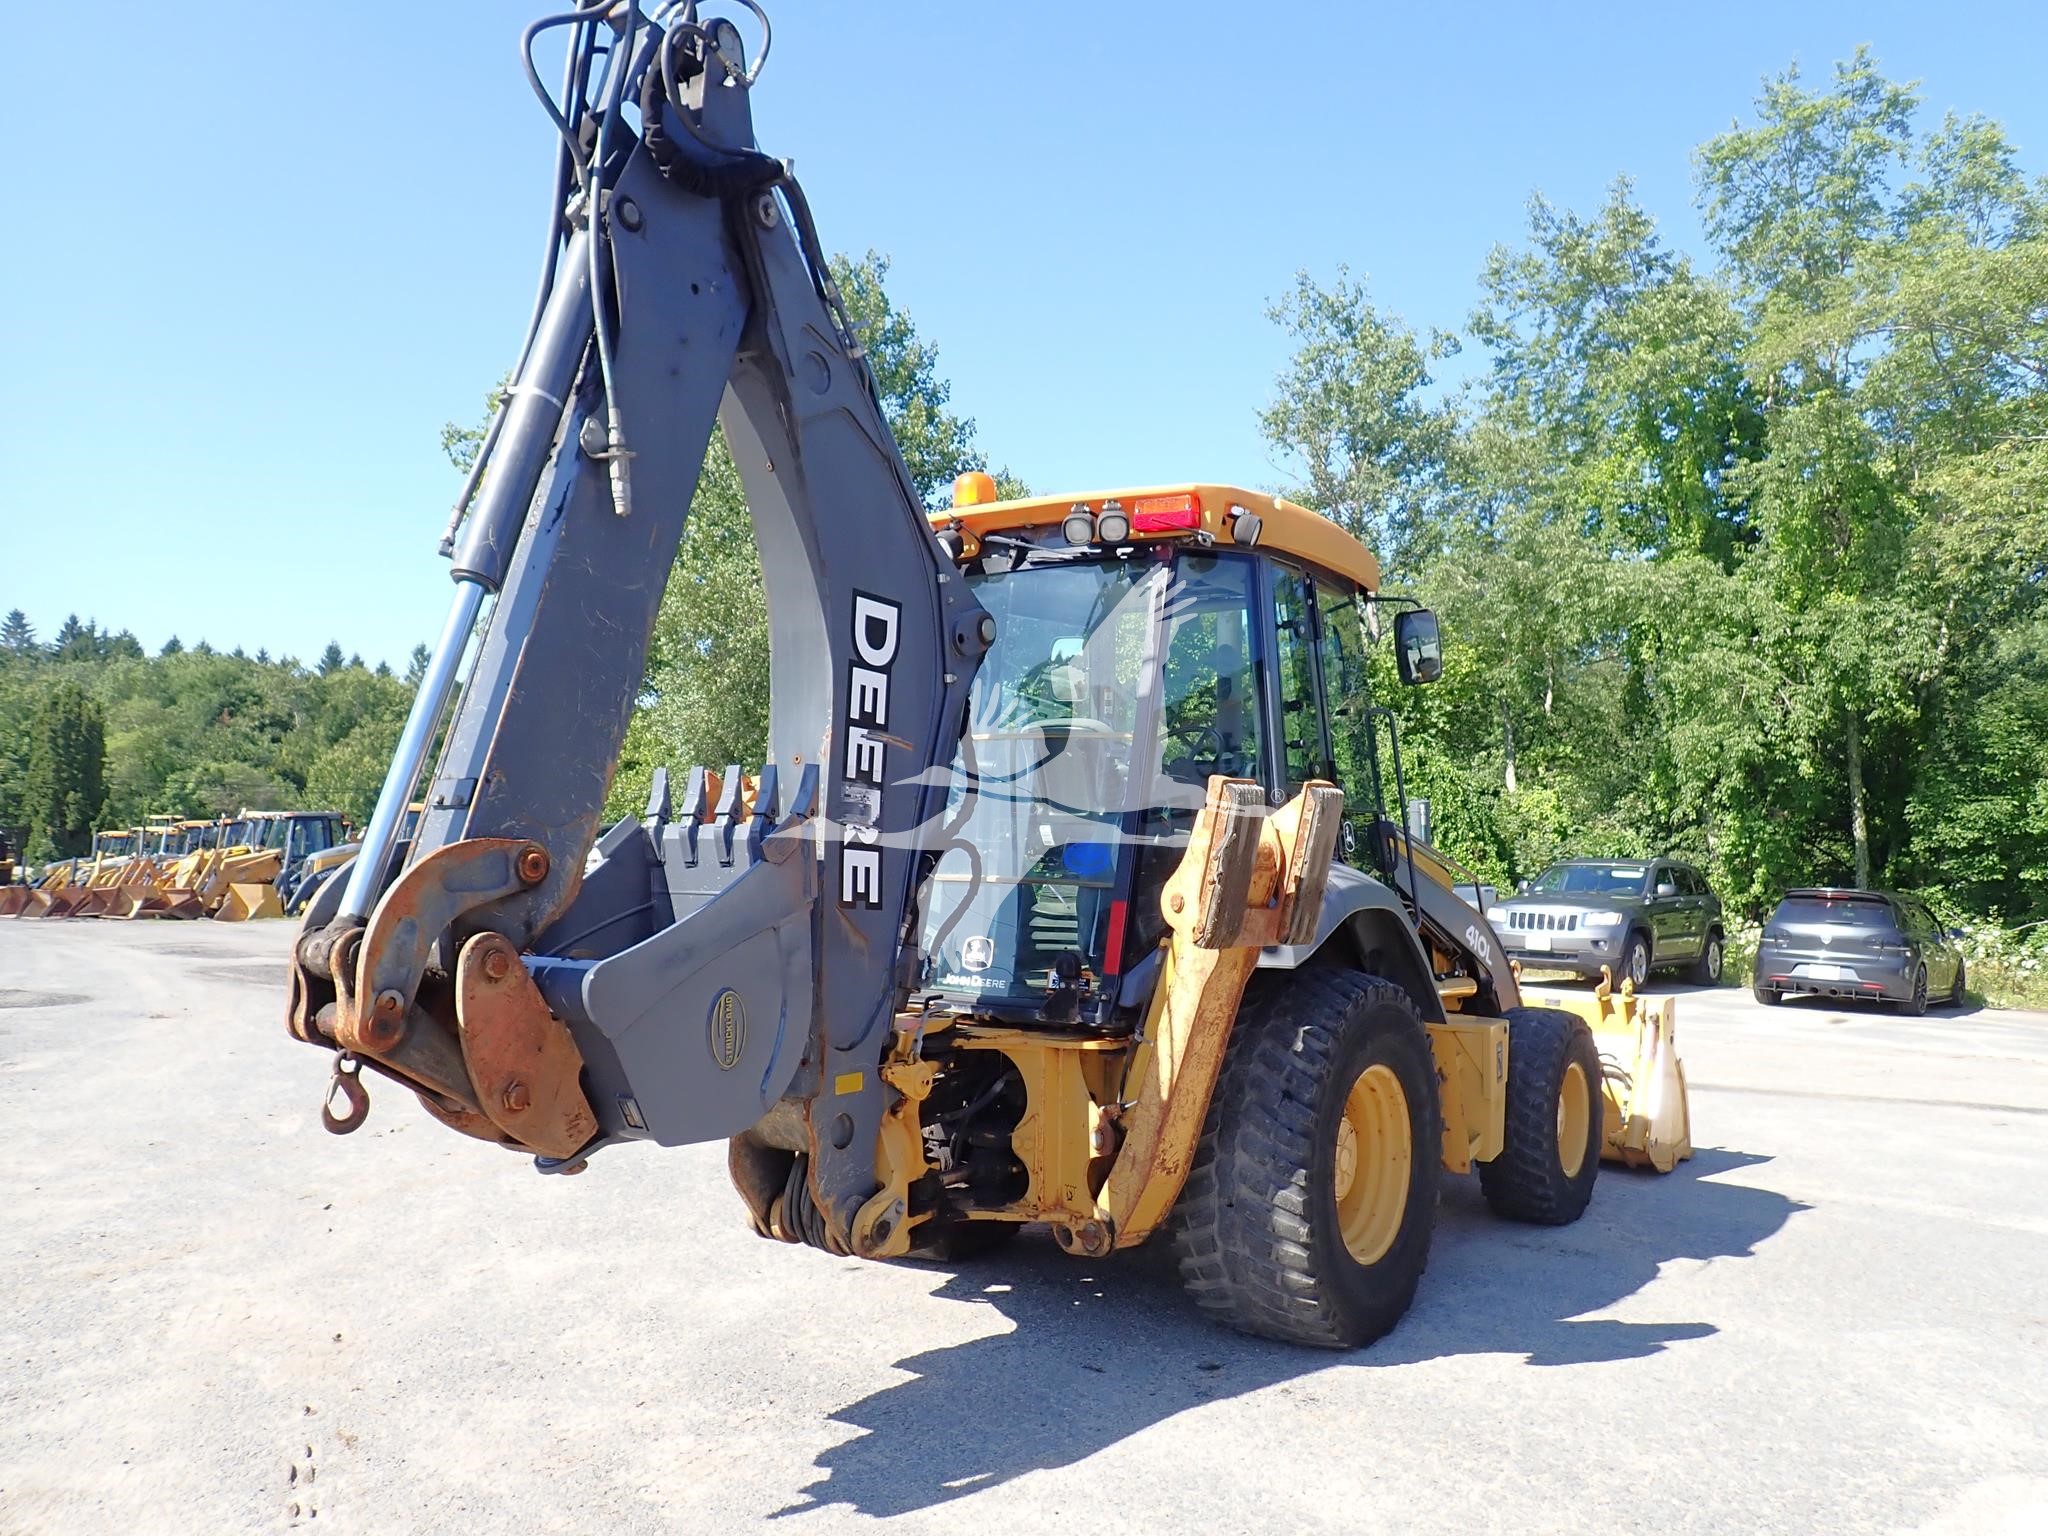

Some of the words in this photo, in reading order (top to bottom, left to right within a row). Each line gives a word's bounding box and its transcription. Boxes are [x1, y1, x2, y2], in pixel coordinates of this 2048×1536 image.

[843, 596, 898, 904] DEERE
[1465, 925, 1492, 966] 410L
[943, 973, 970, 986] JOHN
[971, 975, 1006, 989] DEERE
[725, 996, 734, 1064] STRICKLAND
